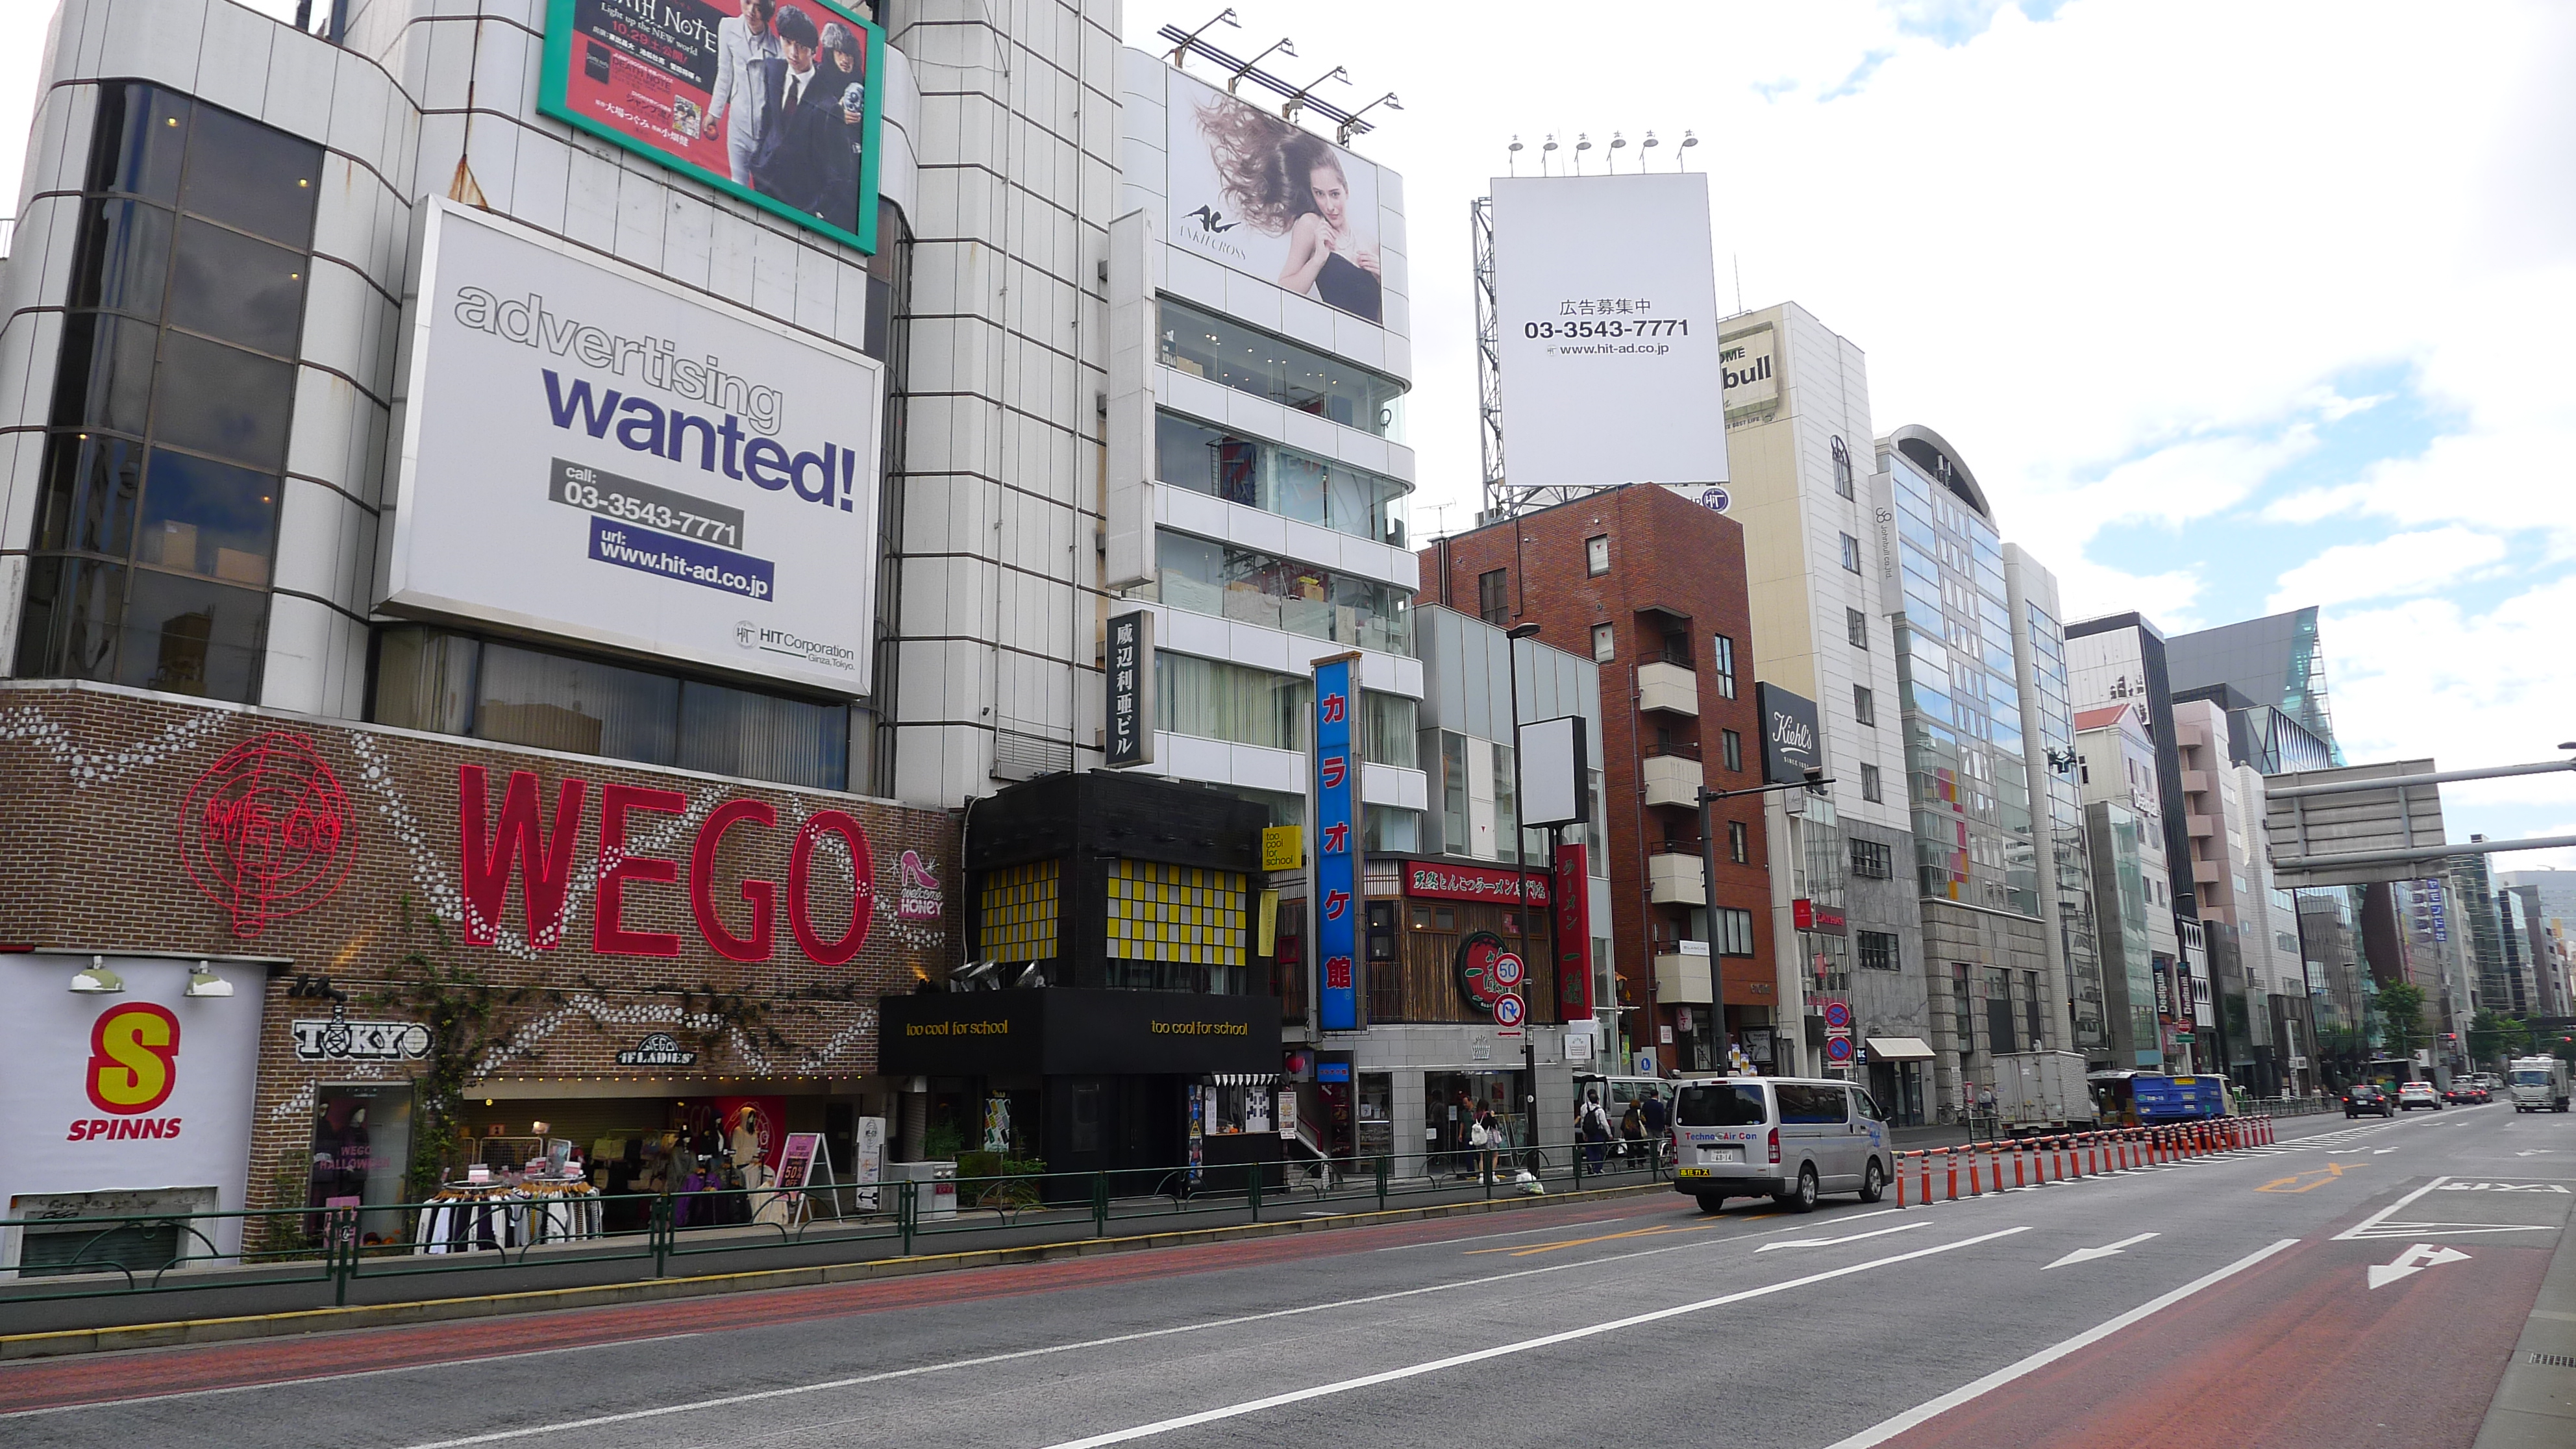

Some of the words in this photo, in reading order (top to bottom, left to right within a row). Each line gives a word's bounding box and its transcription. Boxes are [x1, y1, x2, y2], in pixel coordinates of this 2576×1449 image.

[601, 3, 623, 18] Light
[626, 16, 636, 27] up
[638, 19, 650, 32] the
[652, 27, 676, 43] NEW
[676, 40, 698, 56] world
[612, 20, 648, 45] 10.29
[1559, 297, 1651, 316] 広告募集中
[1524, 319, 1689, 339] 03-3543-7771
[1560, 343, 1669, 355] www.hit-ad.co.jp
[454, 286, 782, 436] advertising
[541, 368, 856, 514] wanted!
[565, 465, 597, 484] call:
[564, 480, 736, 545] 03-3543-7771
[601, 528, 626, 545] url:
[601, 539, 769, 598] www.hit-ad.co.jp
[760, 628, 784, 645] HIT
[784, 634, 854, 660] Corporation
[1772, 712, 1812, 749] Kiehl's
[1784, 756, 1798, 767] SINCE
[1267, 839, 1283, 848] cool
[1322, 693, 1352, 990] カラオケ館
[1267, 849, 1278, 858] for
[1267, 856, 1293, 865] school
[460, 764, 874, 965] WEGO
[900, 887, 943, 900] welcome
[1563, 859, 1578, 930] ラーメン
[1499, 967, 1517, 978] 50
[906, 1024, 923, 1035] too
[925, 1021, 948, 1035] cool
[952, 1021, 969, 1035] for
[970, 1019, 1008, 1035] school
[1151, 1020, 1169, 1033] too
[1172, 1021, 1195, 1035] cool
[1195, 1021, 1213, 1035] for
[1213, 1021, 1248, 1035] school
[293, 1021, 434, 1059] TOKYO
[86, 1002, 180, 1115] S
[66, 1118, 182, 1142] SPINNS
[341, 1146, 372, 1156] WEGO
[785, 1166, 804, 1178] 50%
